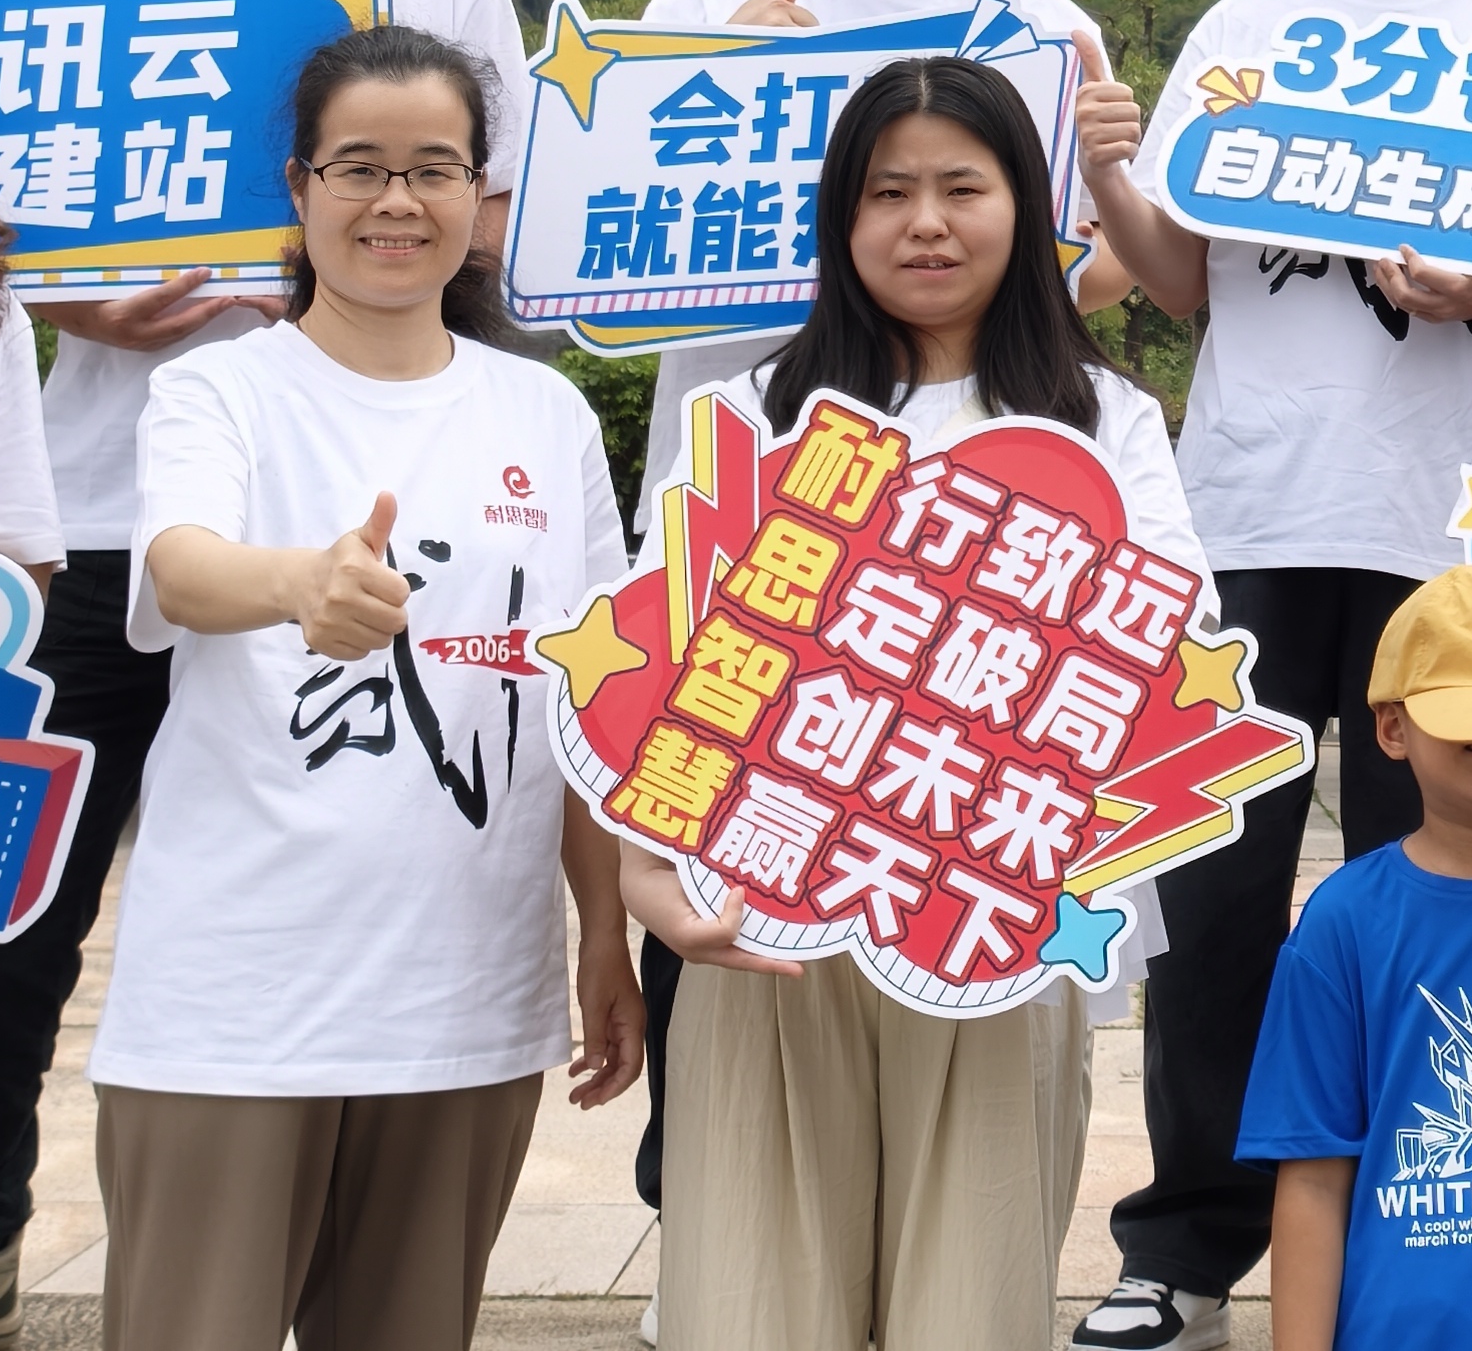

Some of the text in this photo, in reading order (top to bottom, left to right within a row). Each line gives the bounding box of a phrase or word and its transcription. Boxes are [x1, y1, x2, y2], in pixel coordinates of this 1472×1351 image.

[648, 69, 873, 167] 会打
[444, 637, 527, 664] 2006-
[1410, 1220, 1422, 1235] A
[1424, 1218, 1455, 1234] cool
[1405, 1231, 1449, 1248] march
